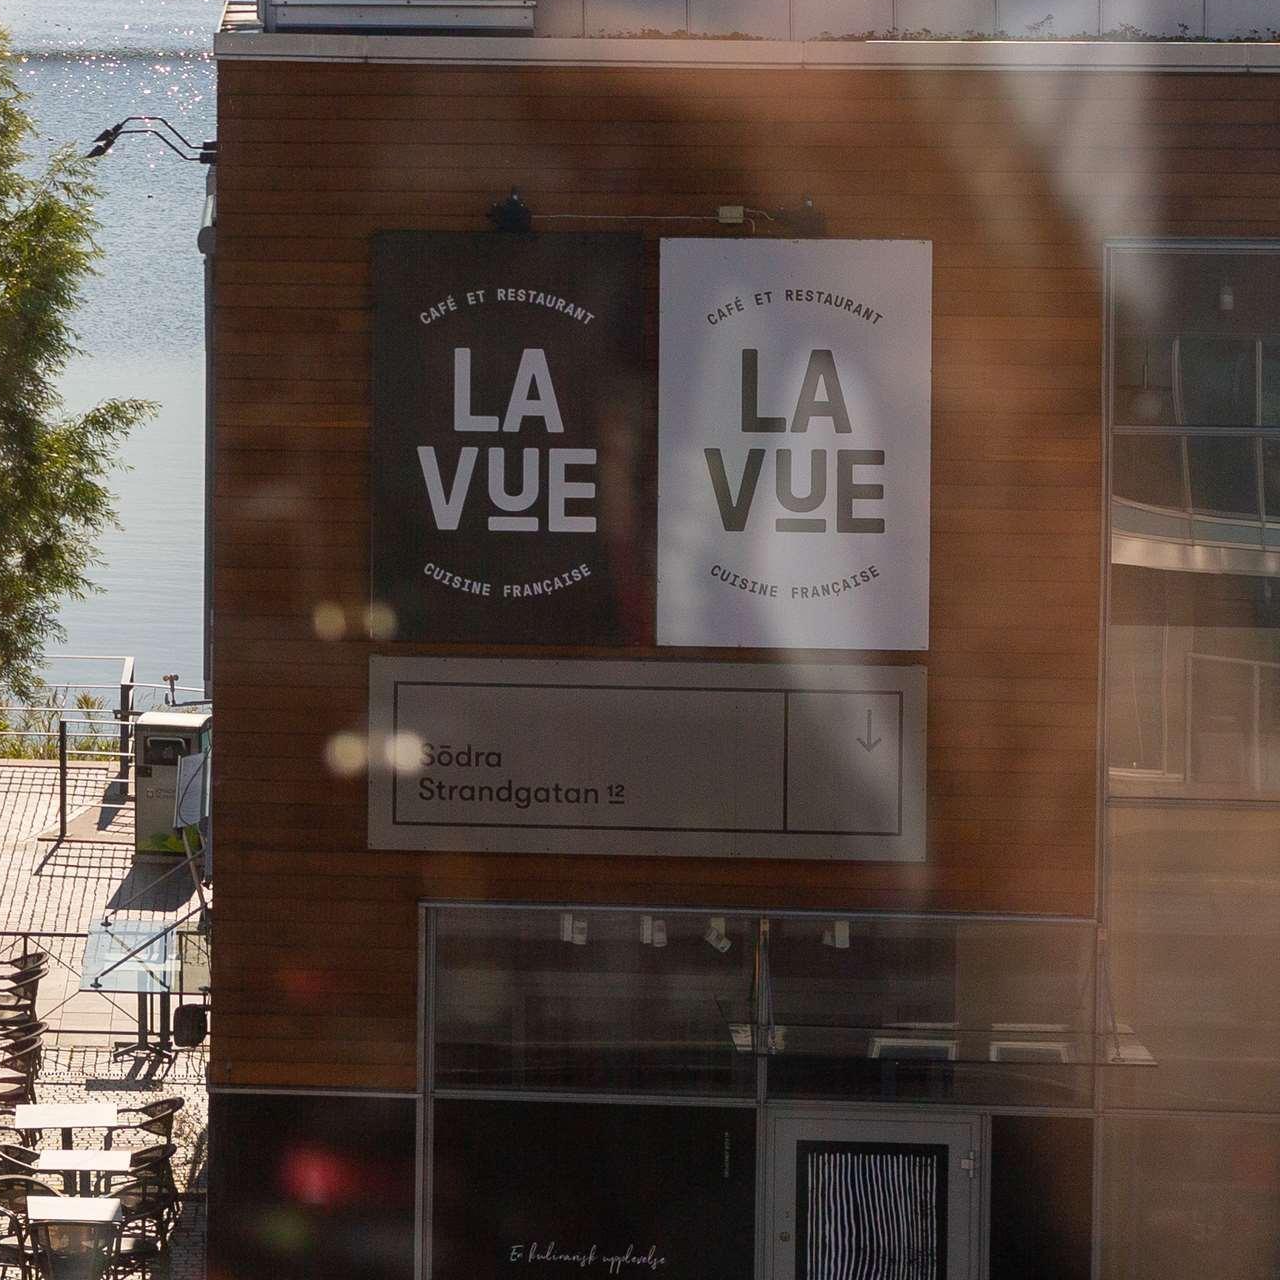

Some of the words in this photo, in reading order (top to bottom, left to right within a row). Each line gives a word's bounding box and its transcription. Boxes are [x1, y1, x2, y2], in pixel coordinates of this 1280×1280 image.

[420, 295, 457, 324] CAFÉ
[466, 290, 485, 305] ET
[497, 288, 595, 325] RESTAURANT
[707, 296, 745, 326] CAFÉ
[754, 291, 773, 306] ET
[785, 289, 883, 325] RESTAURANT
[454, 347, 564, 432] LA
[741, 348, 853, 433] LA
[417, 446, 597, 532] VUE
[704, 448, 885, 534] VUE
[424, 563, 491, 596] CUISINE
[503, 563, 592, 597] FRANÇAISE
[710, 564, 778, 598] CUISINE
[791, 565, 880, 599] FRANÇAISE
[419, 777, 599, 809] Strandgatan
[607, 784, 625, 804] 12
